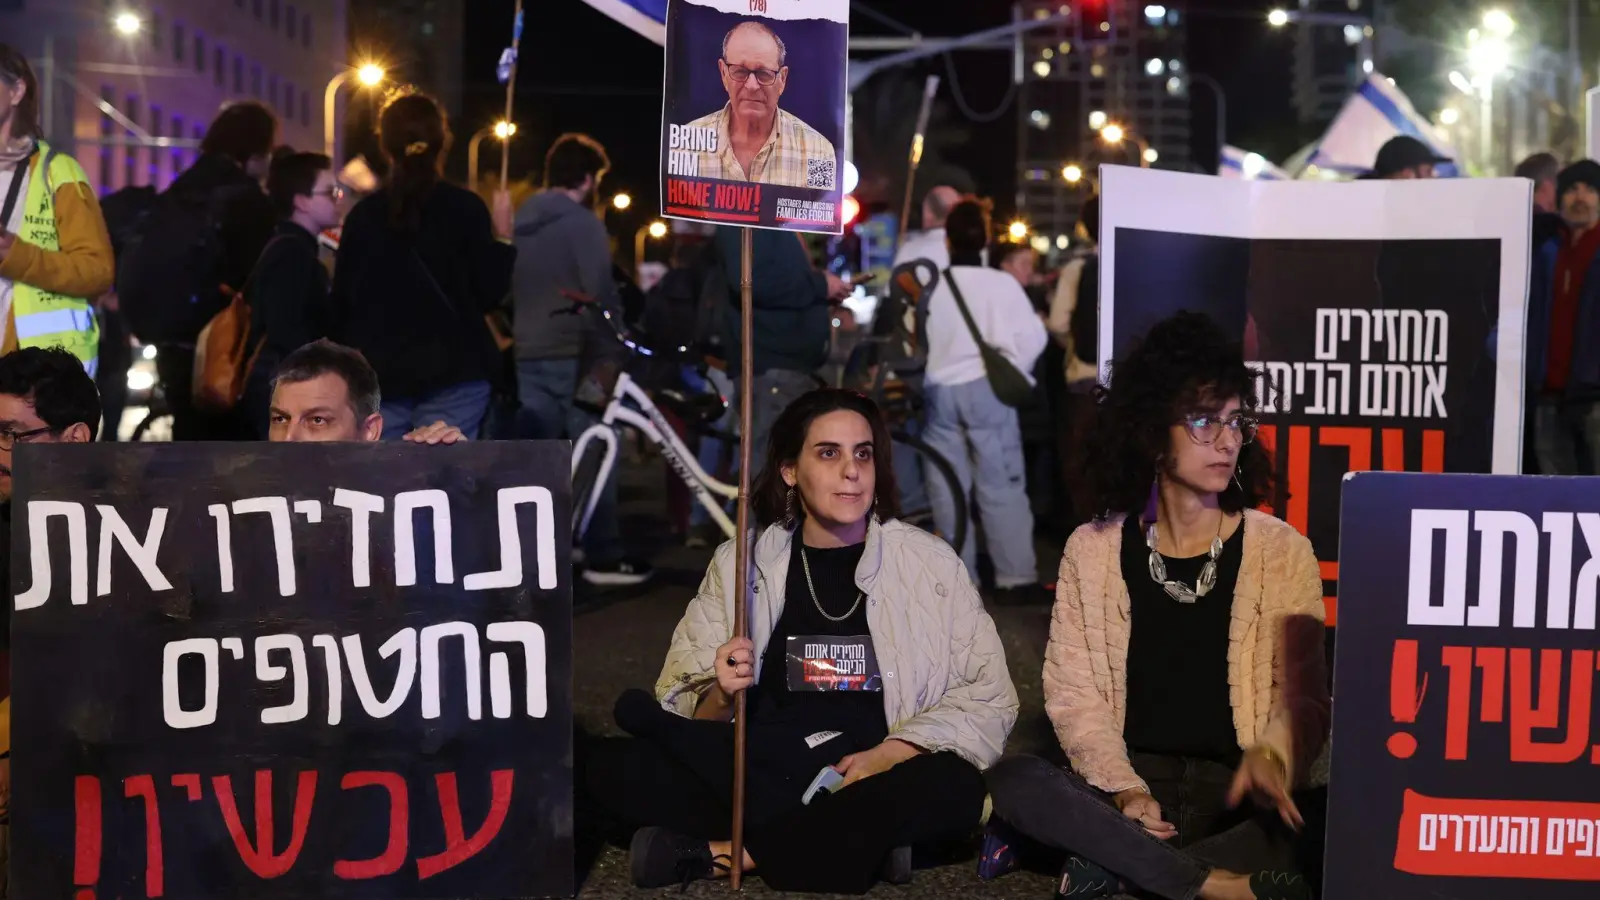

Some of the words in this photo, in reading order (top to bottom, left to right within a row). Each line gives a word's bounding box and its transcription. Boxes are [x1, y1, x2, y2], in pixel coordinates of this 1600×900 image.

[749, 0, 767, 13] (78)
[669, 123, 718, 153] BRING
[667, 151, 699, 177] HIM
[667, 178, 711, 208] HOME
[714, 183, 762, 212] NOW!
[777, 198, 802, 209] HOSTAGES
[802, 200, 813, 209] AND
[812, 201, 835, 211] MISSING
[776, 206, 808, 220] FAMILIES
[808, 210, 834, 223] FORUM
[1315, 308, 1449, 362] מחזירים
[1359, 363, 1448, 418] אותם
[15, 500, 173, 611] את
[208, 485, 558, 597] תחזירו
[804, 643, 829, 659] אותם
[830, 644, 865, 660] מחזירים
[836, 659, 866, 675] הביתה
[163, 620, 548, 728] החטופים
[74, 769, 514, 900] עכשיו!
[1418, 813, 1540, 855] והנעדרים
